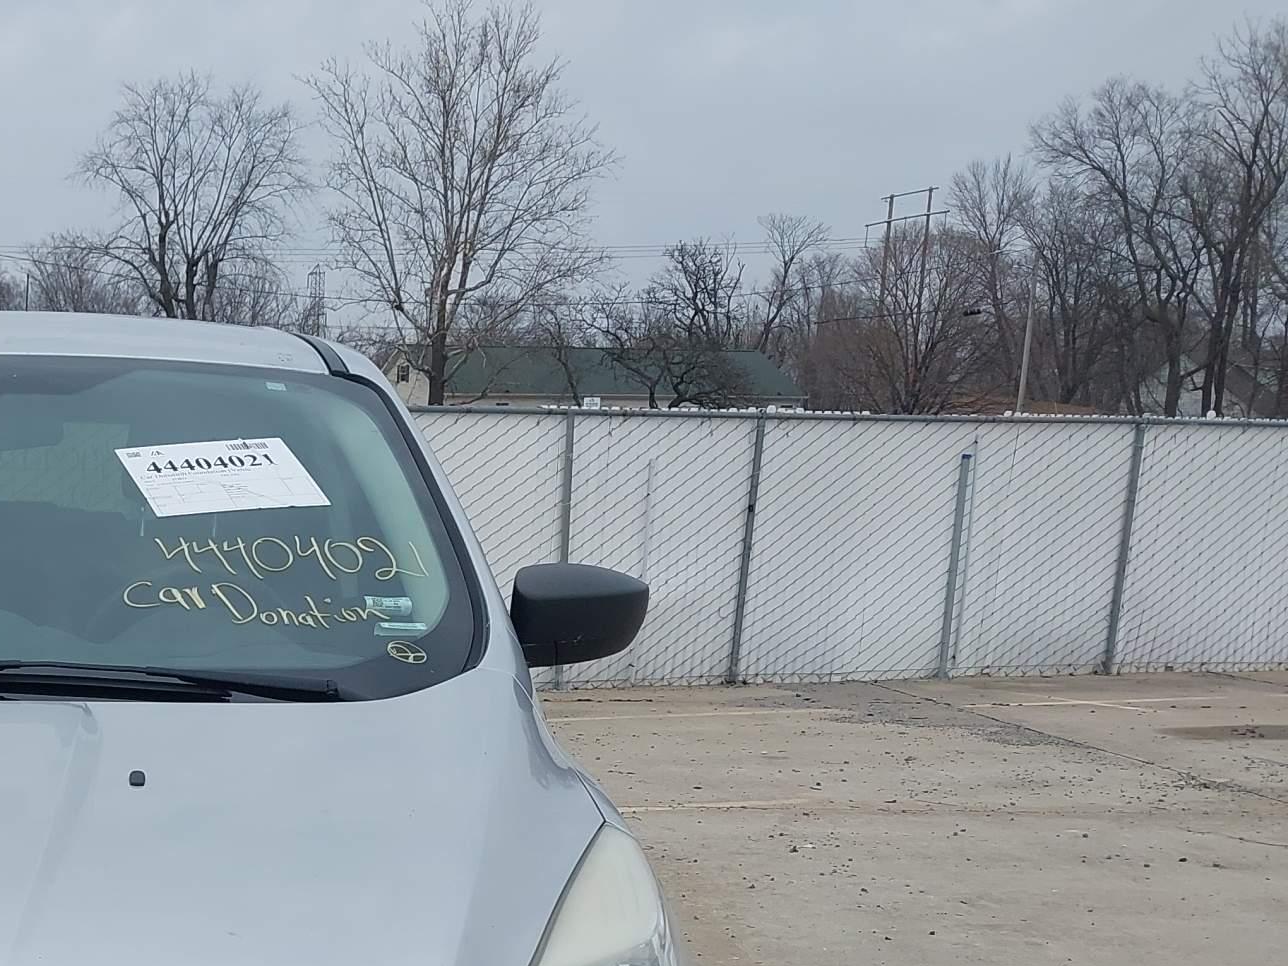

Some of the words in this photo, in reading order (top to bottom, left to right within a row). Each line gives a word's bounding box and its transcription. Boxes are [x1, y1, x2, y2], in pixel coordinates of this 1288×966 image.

[146, 453, 278, 474] 44404021
[154, 536, 429, 580] 44404021
[123, 581, 207, 609] Car
[210, 582, 391, 630] Donation
